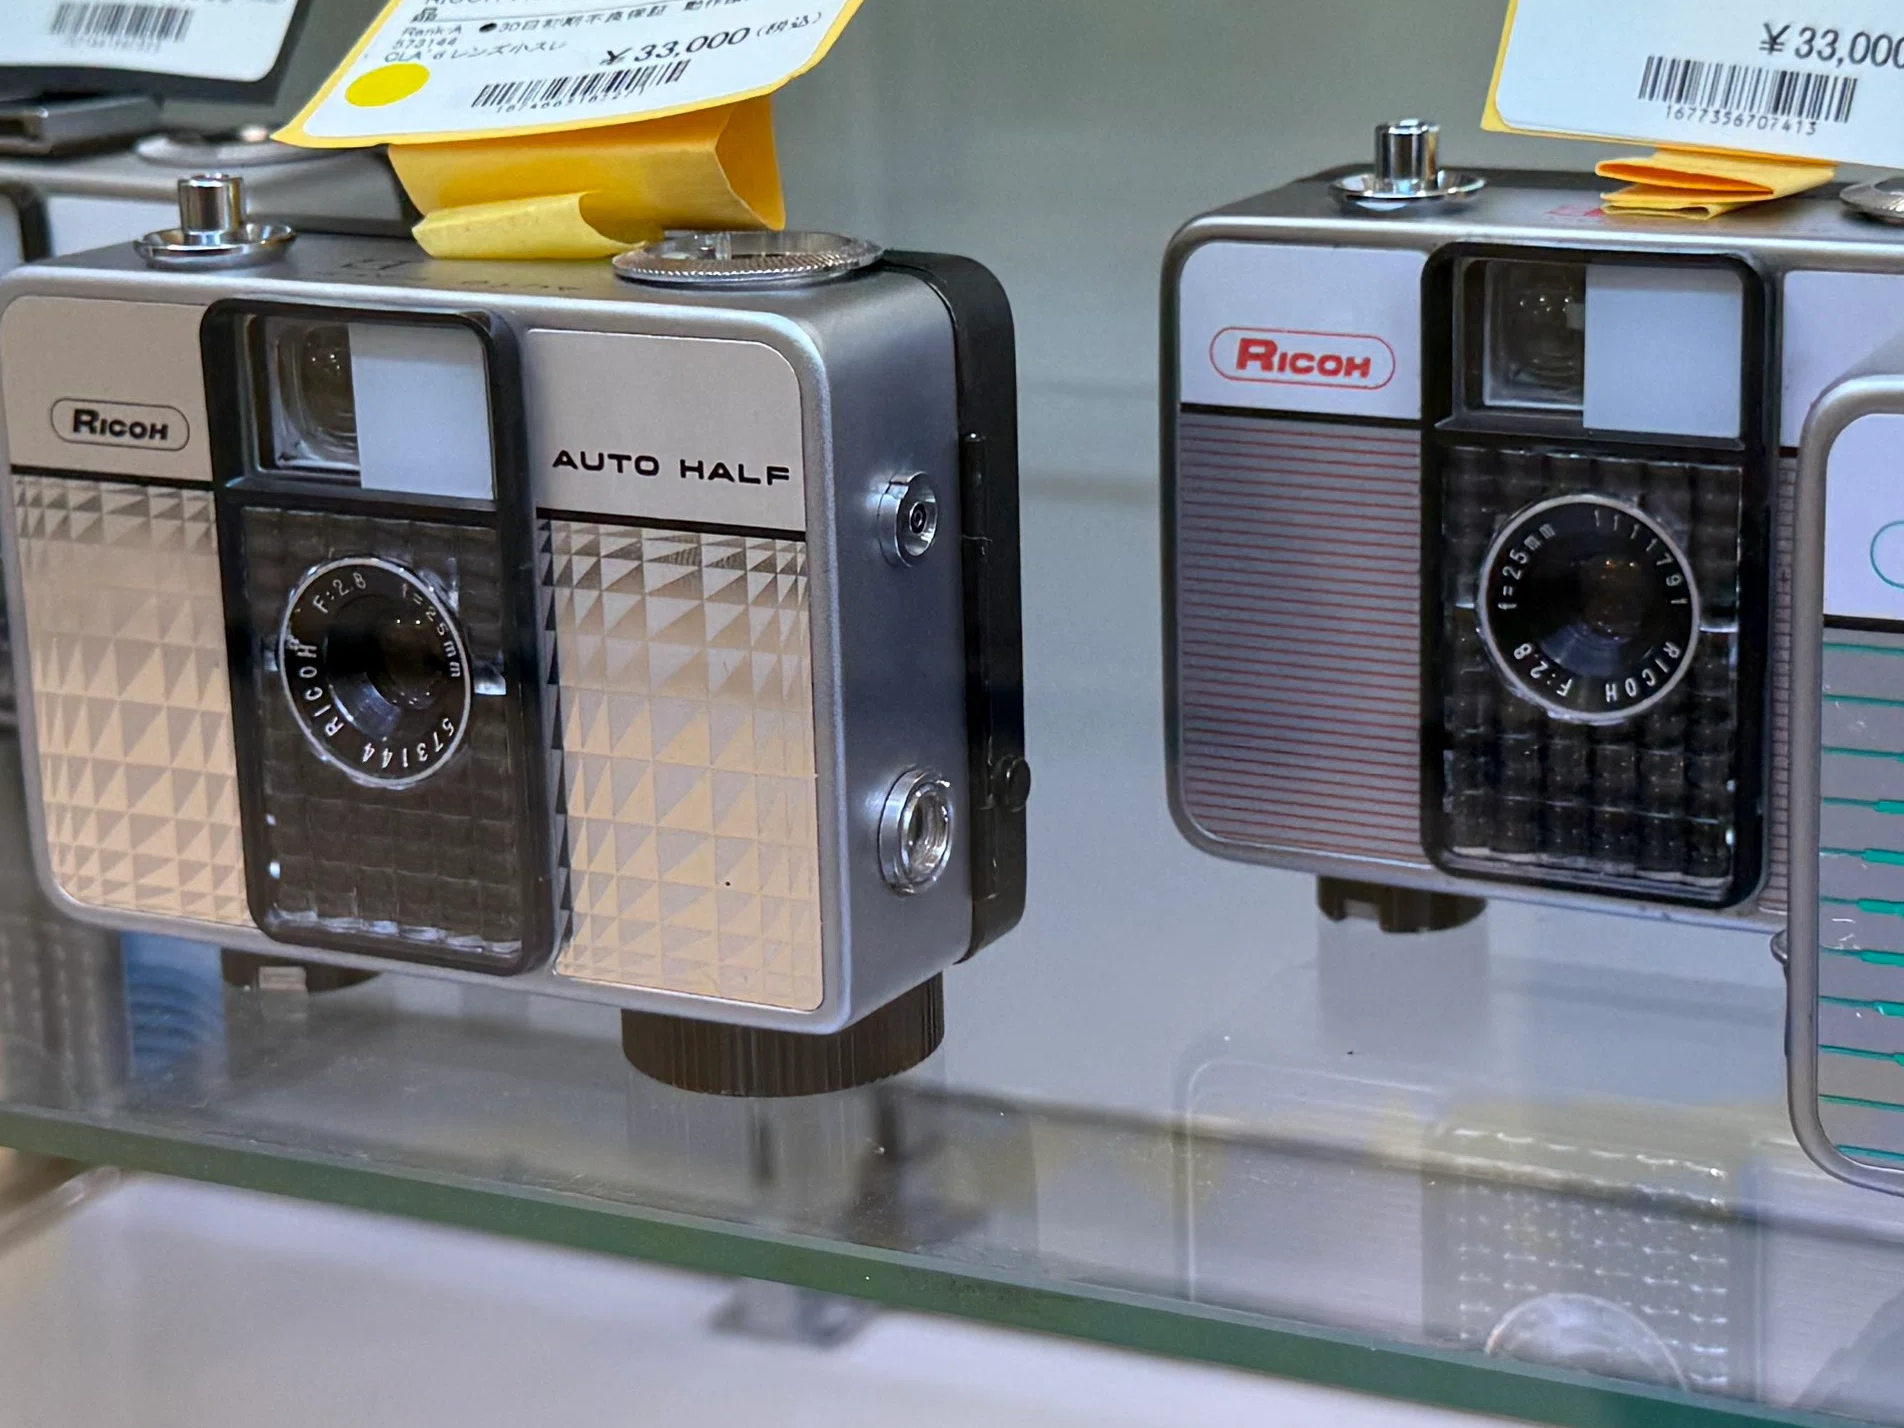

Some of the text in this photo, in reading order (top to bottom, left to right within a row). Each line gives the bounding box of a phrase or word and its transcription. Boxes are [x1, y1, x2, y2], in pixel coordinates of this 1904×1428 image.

[599, 27, 751, 67] ¥33,000
[1236, 338, 1371, 380] RICOH
[71, 408, 169, 442] RICOH
[552, 448, 792, 487] AUTO HALF
[297, 645, 345, 737] RICOH
[1602, 642, 1683, 702] RICOH
[361, 718, 455, 769] 573144
